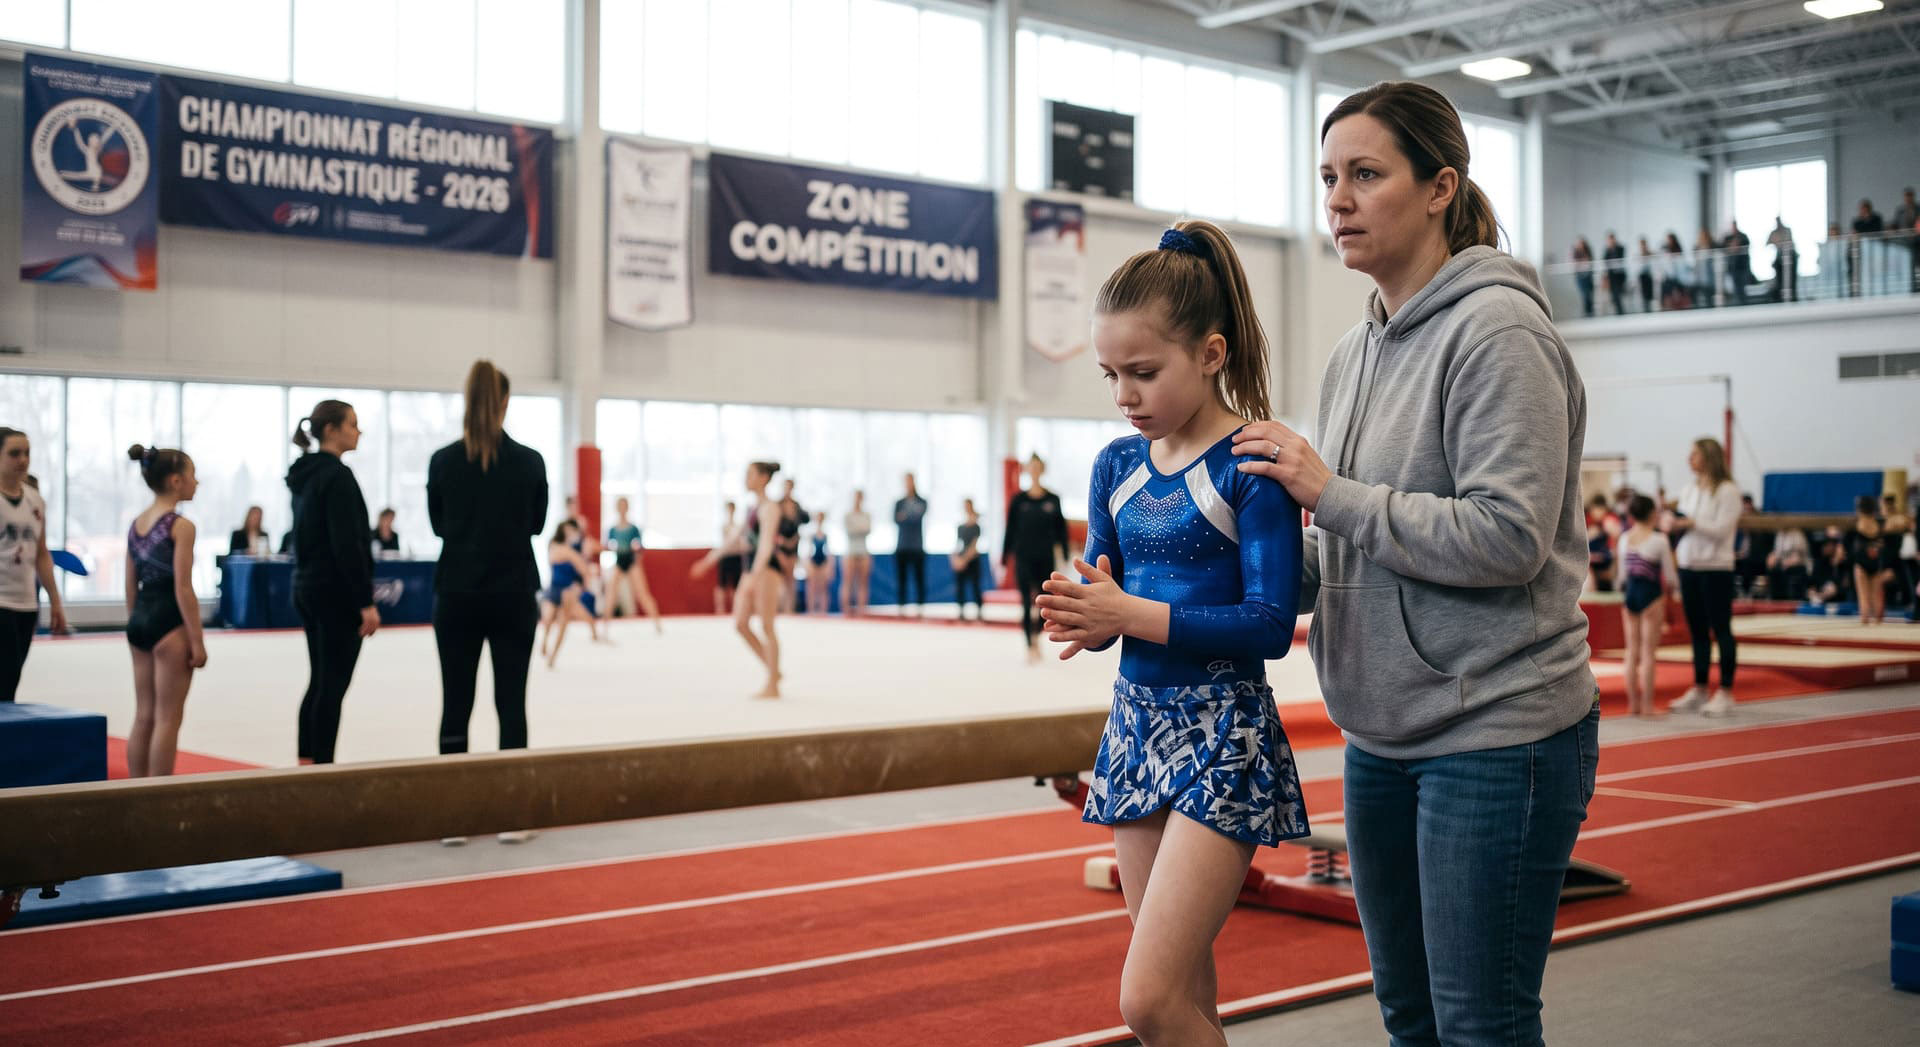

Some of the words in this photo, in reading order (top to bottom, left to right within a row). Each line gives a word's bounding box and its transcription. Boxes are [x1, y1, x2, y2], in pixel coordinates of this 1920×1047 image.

[179, 96, 382, 156] CHAMPIONNAT
[387, 117, 513, 172] RÉGIONAL
[181, 141, 220, 181] DE
[226, 146, 420, 205] GYMNASTIQUE
[426, 186, 437, 196] -
[443, 172, 510, 213] 2026
[806, 179, 910, 230] ZONE
[729, 220, 979, 283] COMPÉTITION
